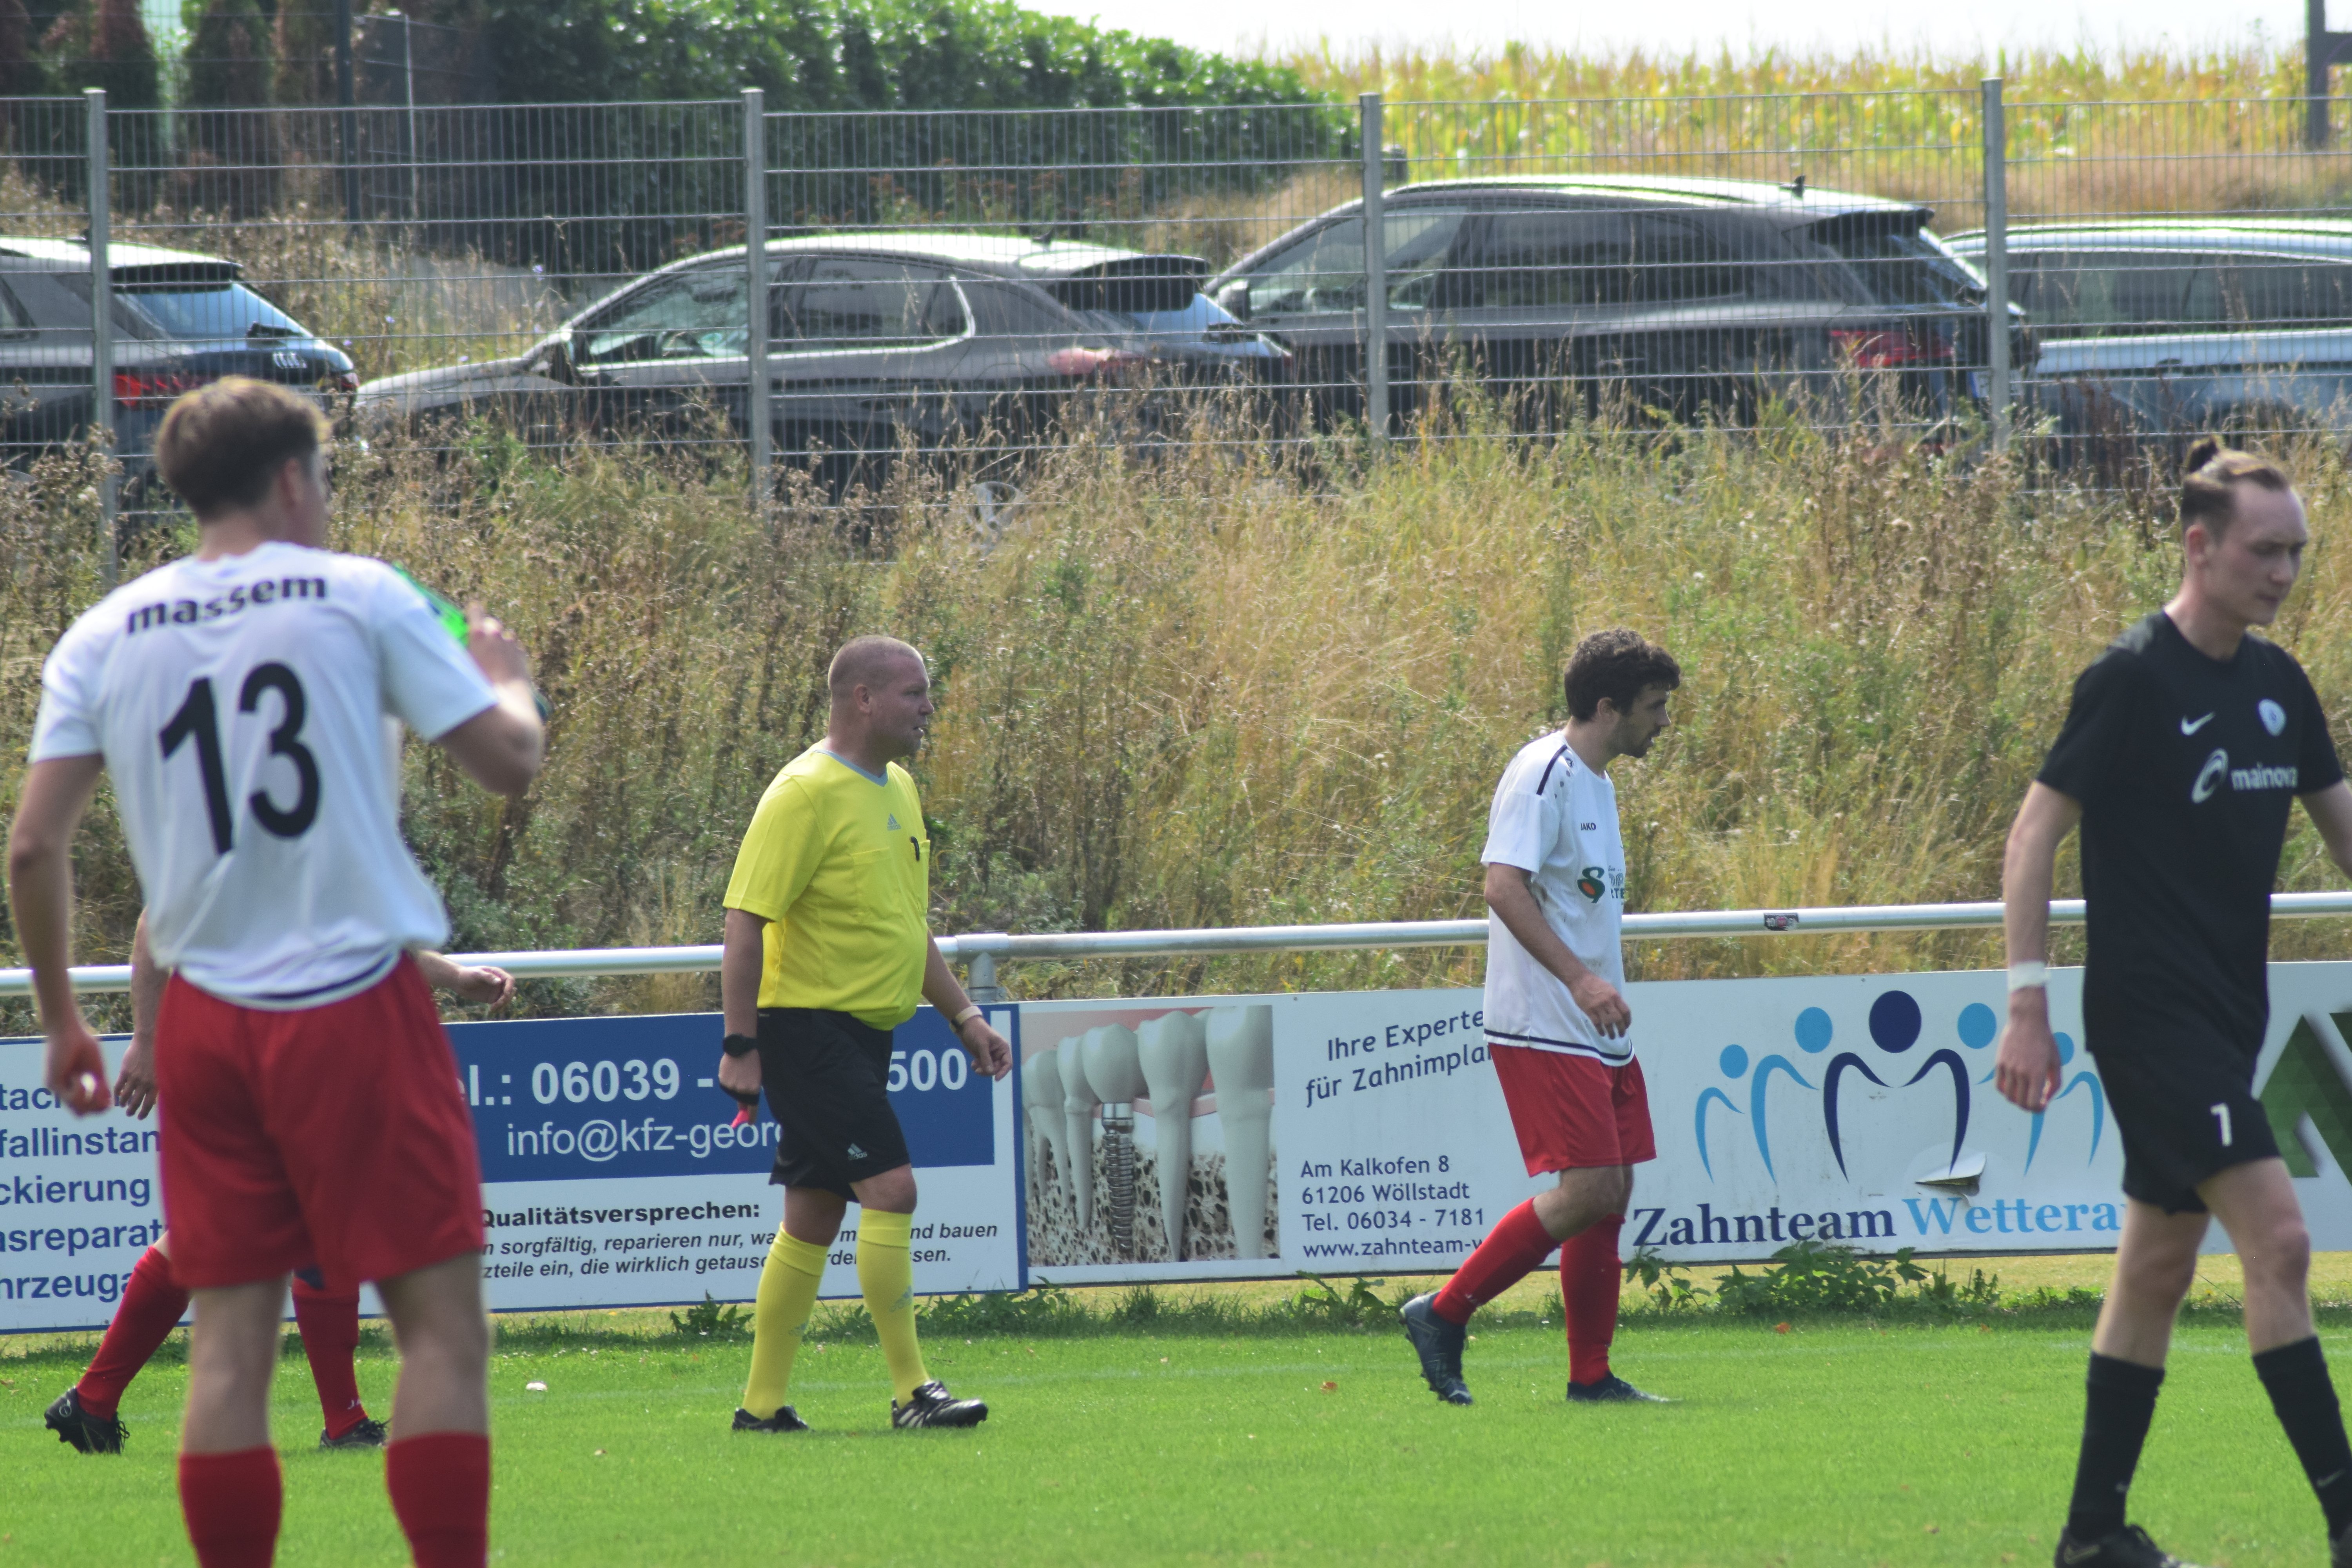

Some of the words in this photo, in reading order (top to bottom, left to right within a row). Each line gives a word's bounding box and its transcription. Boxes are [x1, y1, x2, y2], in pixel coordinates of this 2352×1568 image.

[128, 577, 326, 633] massem
[159, 662, 321, 855] 13
[1581, 822, 1596, 831] JAKO
[1328, 1035, 1376, 1061] Ihre
[532, 1058, 680, 1104] 06039
[886, 1048, 967, 1092] 500
[1306, 1076, 1342, 1108] für
[1352, 1044, 1492, 1092] Zahnimpla
[2209, 1102, 2232, 1147] 1
[1300, 1160, 1332, 1178] Am
[1340, 1156, 1430, 1176] Kalkofen
[1438, 1155, 1450, 1173] 8
[1302, 1185, 1365, 1205] 61206
[1372, 1181, 1470, 1202] Wöllstadt
[482, 1201, 759, 1229] Qualitätsversprechen:
[1301, 1213, 1338, 1231] Tel.
[1347, 1210, 1412, 1229] 06034
[1435, 1208, 1483, 1227] 7181
[1632, 1203, 1897, 1247] Zahnteam
[500, 1237, 597, 1257] sorgfältig,
[604, 1233, 701, 1253] reparieren
[708, 1233, 743, 1248] nur,
[939, 1223, 998, 1238] bauen
[540, 1260, 573, 1278] ein,
[581, 1259, 609, 1274] die
[616, 1255, 689, 1274] wirklich
